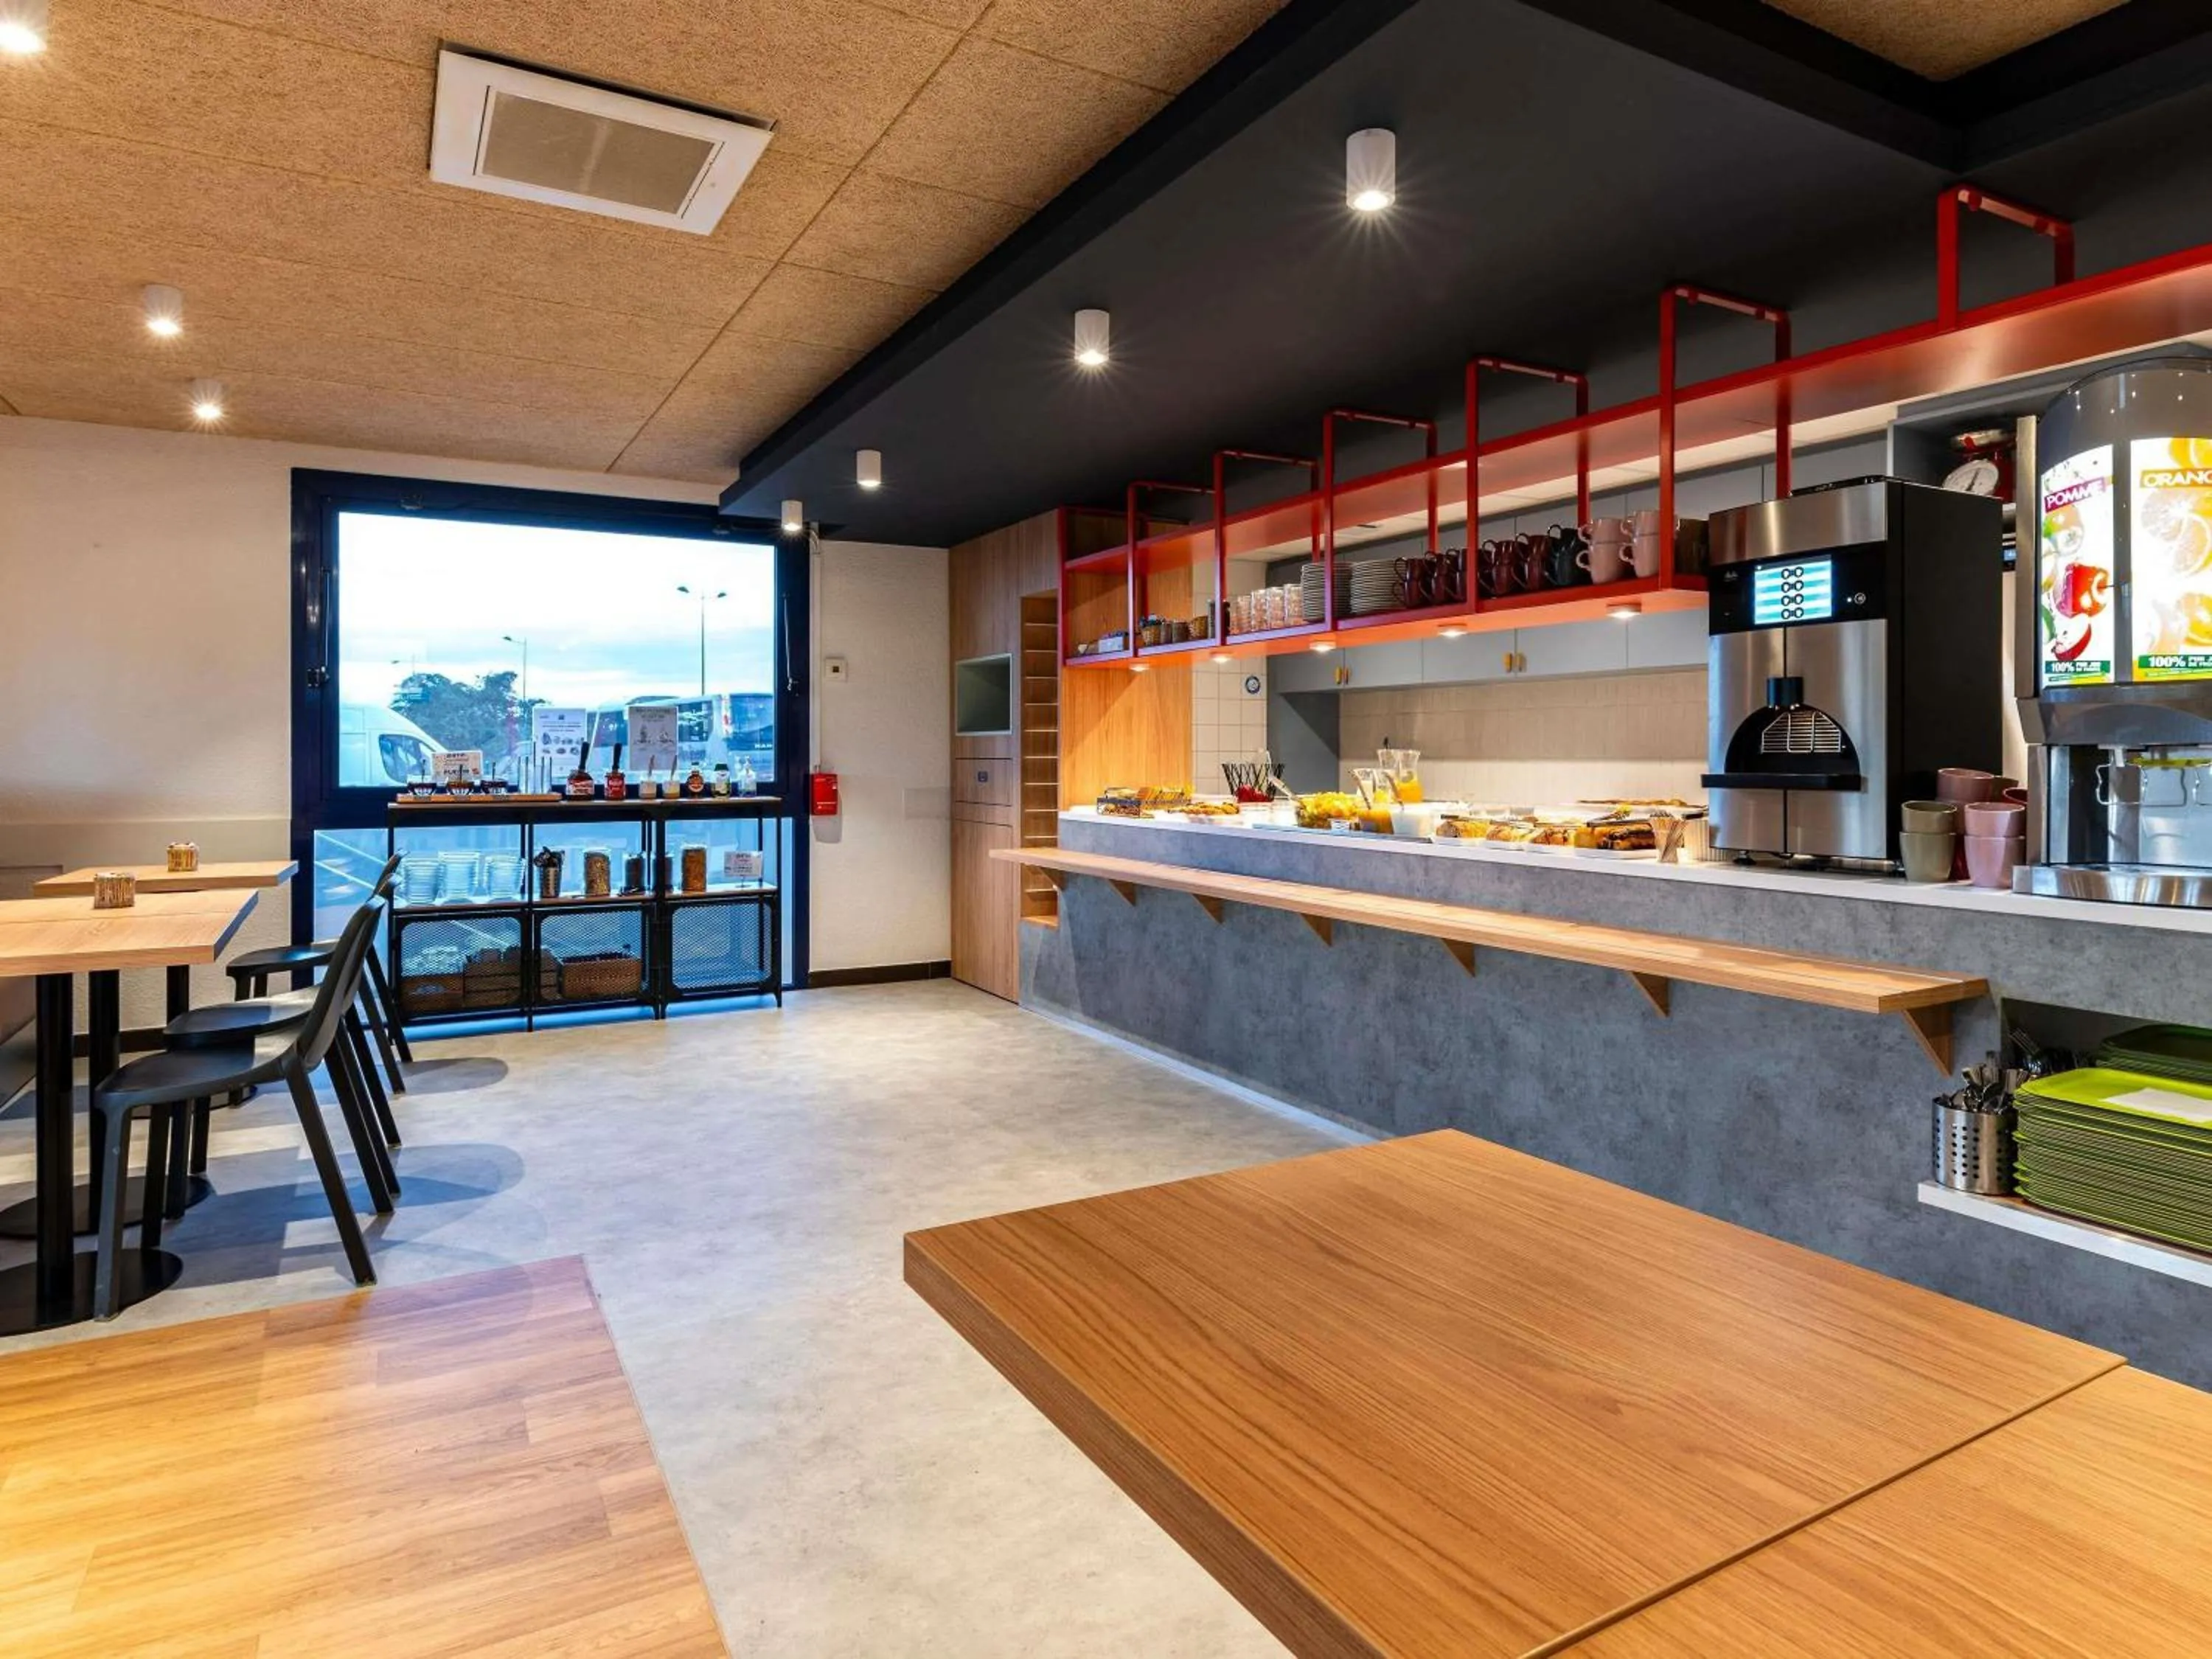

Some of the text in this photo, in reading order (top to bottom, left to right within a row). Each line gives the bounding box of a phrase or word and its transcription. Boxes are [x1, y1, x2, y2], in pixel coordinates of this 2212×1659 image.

[2047, 480, 2103, 509] POMME
[2052, 661, 2076, 672] 100%
[2149, 655, 2185, 667] 100%
